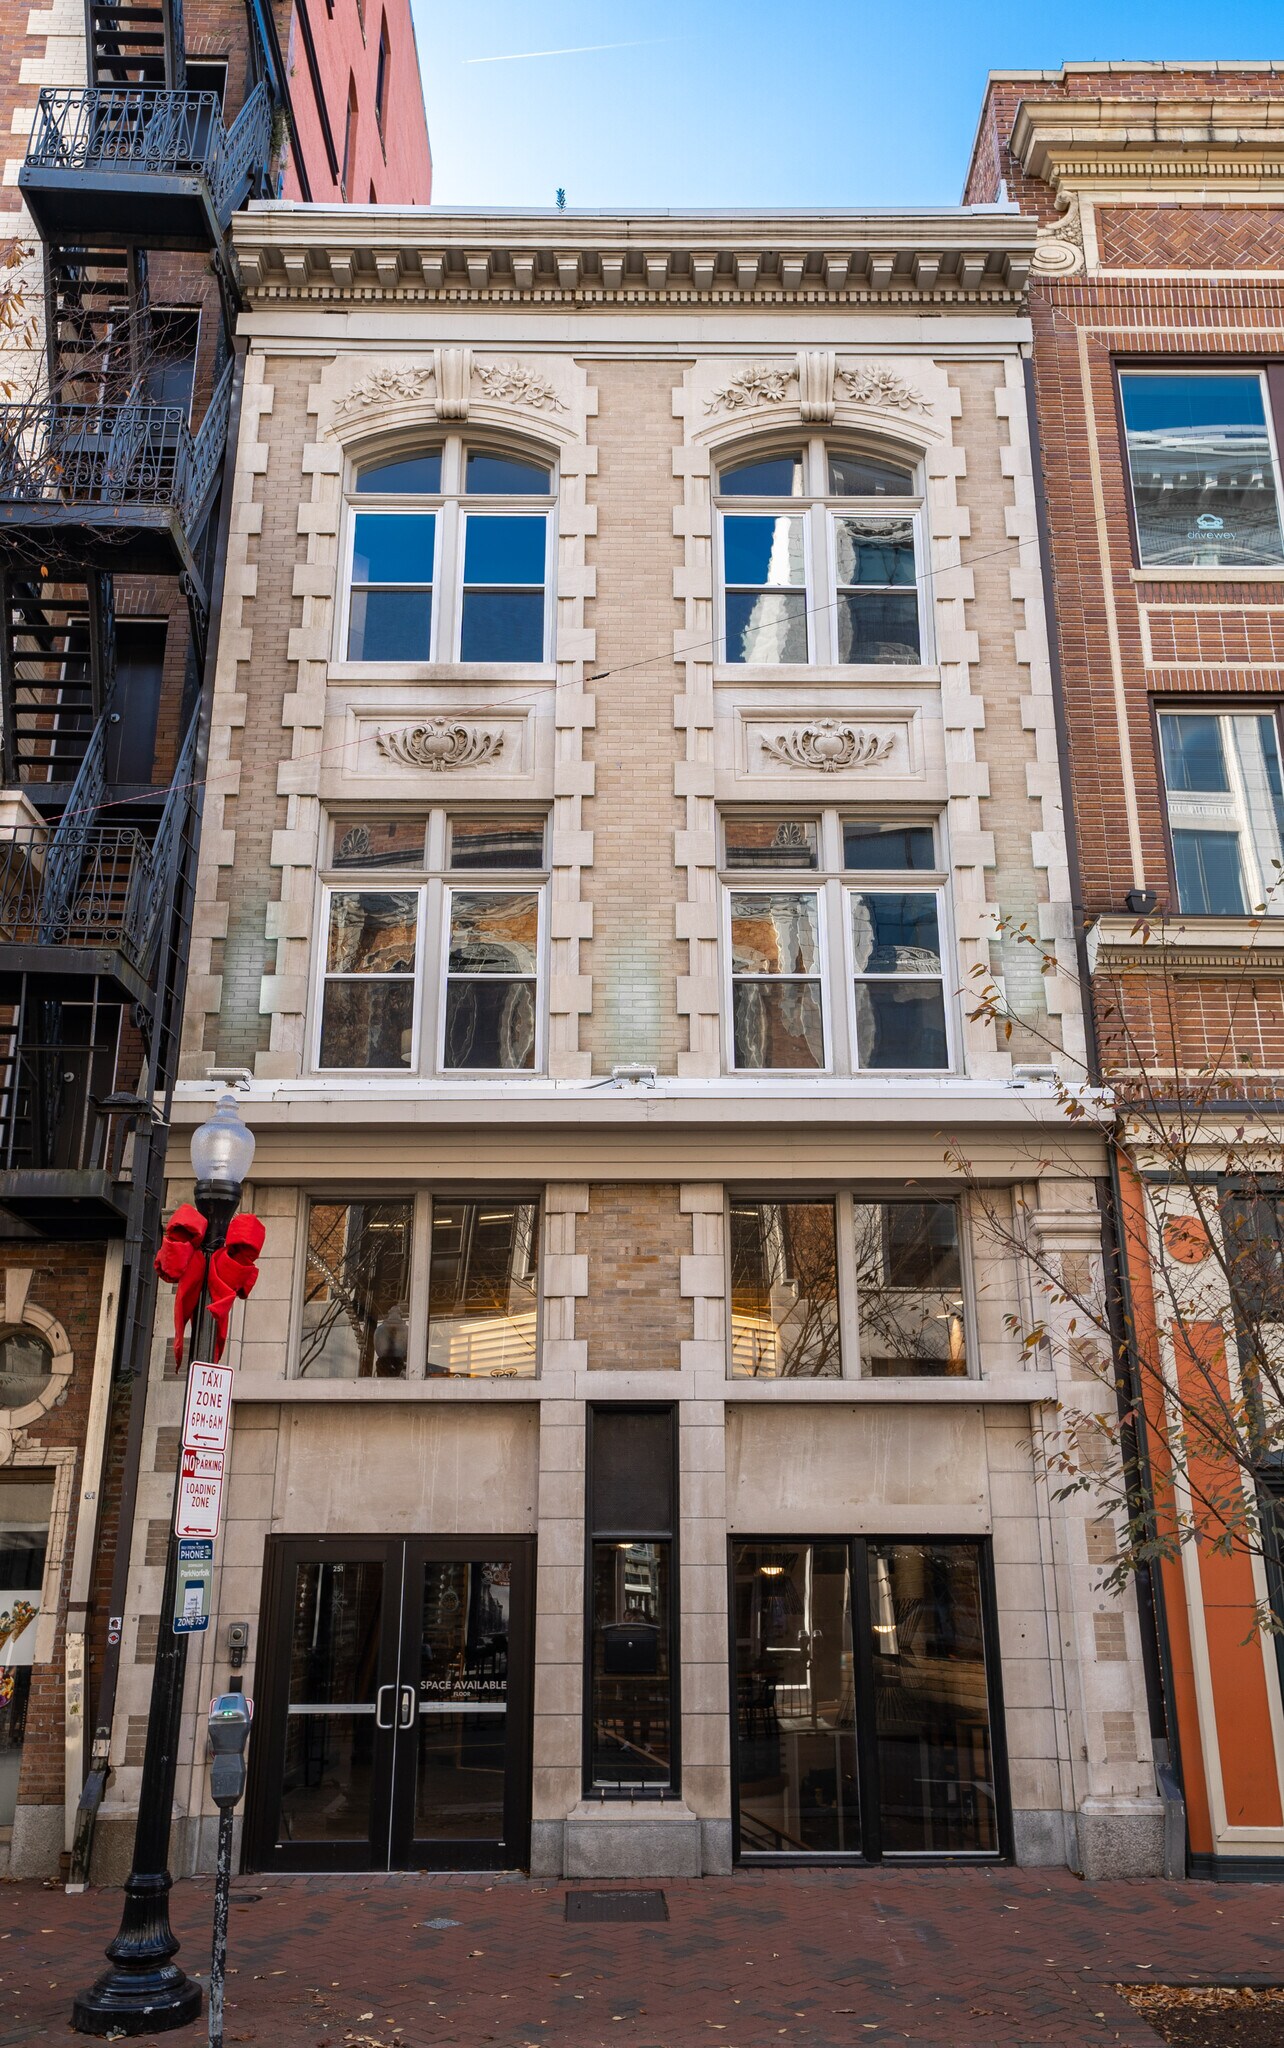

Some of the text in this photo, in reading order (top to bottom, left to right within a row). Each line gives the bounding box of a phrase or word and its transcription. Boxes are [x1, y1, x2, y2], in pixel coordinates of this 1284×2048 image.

[1187, 530, 1237, 541] drivewey
[202, 1371, 223, 1388] TAXI
[196, 1391, 223, 1408] ZONE
[191, 1412, 224, 1430] 6PM-6AM
[183, 1454, 222, 1471] NO PARKING
[186, 1483, 217, 1495] LOADING
[191, 1496, 210, 1508] ZONE
[180, 1550, 204, 1559] PHONE
[180, 1568, 210, 1578] ParkNorfolk
[177, 1616, 206, 1627] ZONE 757
[420, 1680, 508, 1690] SPACE AVAILABLE
